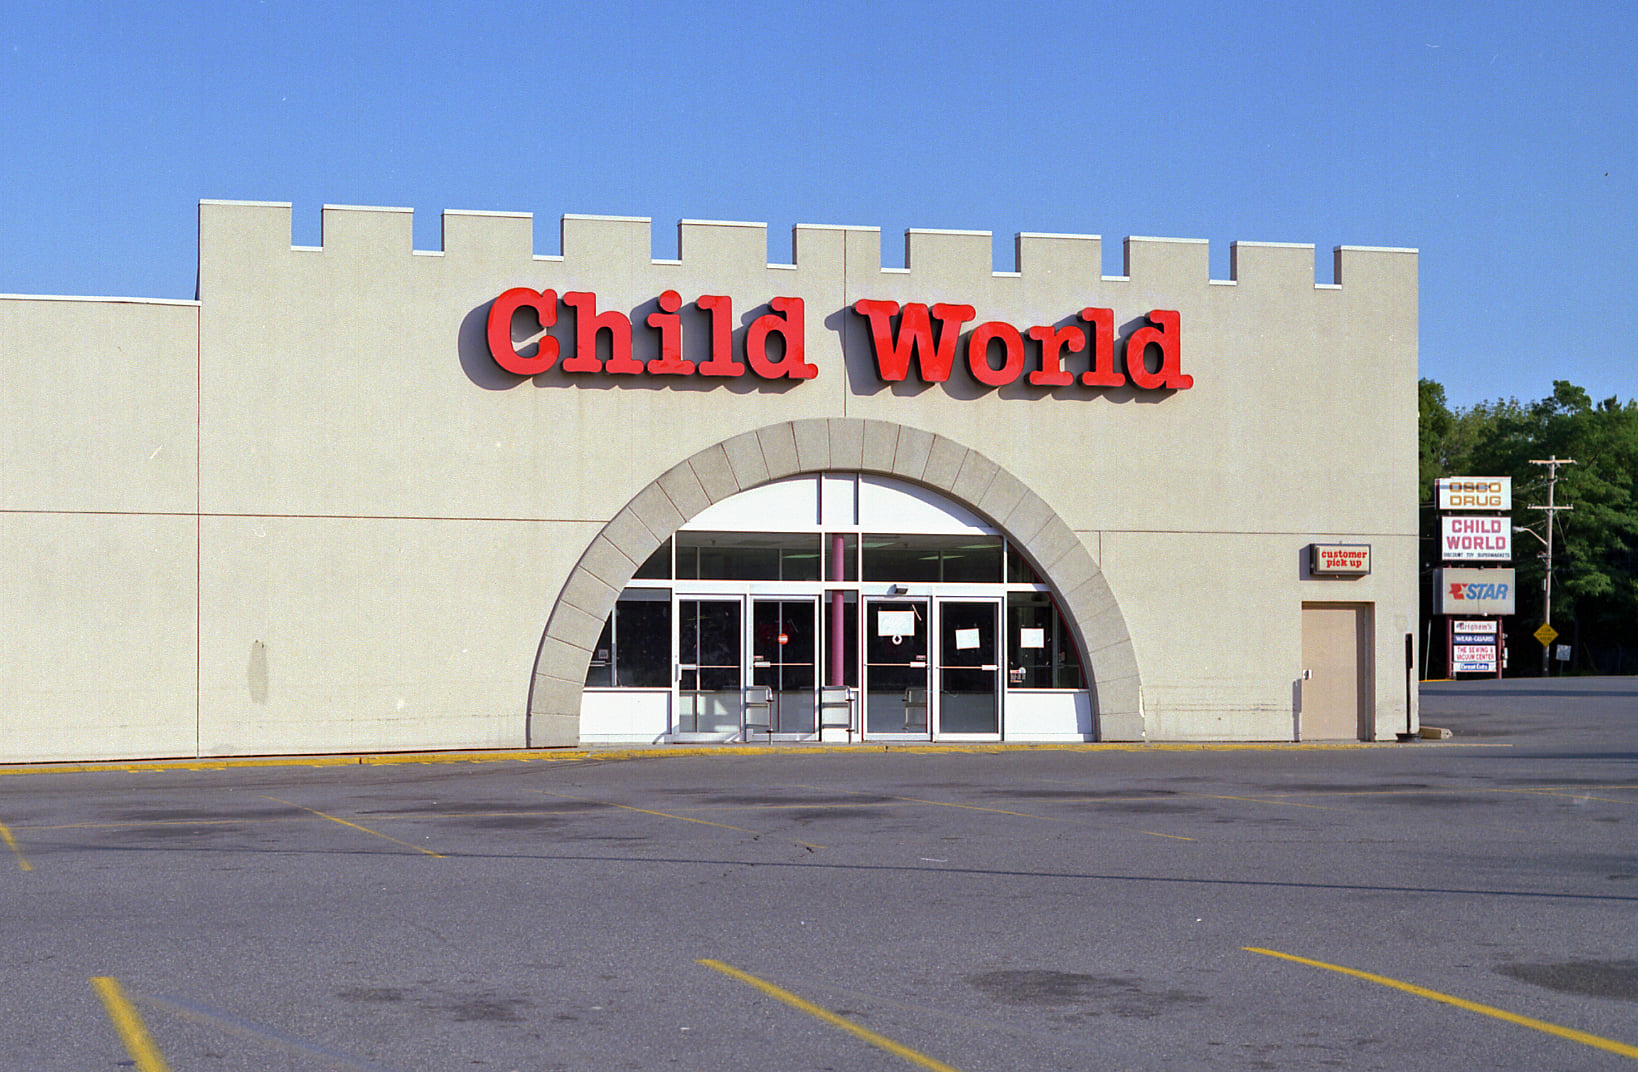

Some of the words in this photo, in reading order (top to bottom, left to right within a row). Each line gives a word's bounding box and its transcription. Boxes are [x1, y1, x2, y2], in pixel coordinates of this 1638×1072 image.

[487, 287, 818, 380] Child
[855, 299, 1194, 390] World
[1449, 482, 1501, 493] OSCO
[1449, 495, 1501, 506] DRUG
[1452, 519, 1501, 534] CHILD
[1447, 536, 1506, 550] WORLD
[1321, 550, 1367, 558] customer
[1326, 559, 1348, 568] pick
[1349, 560, 1362, 568] up
